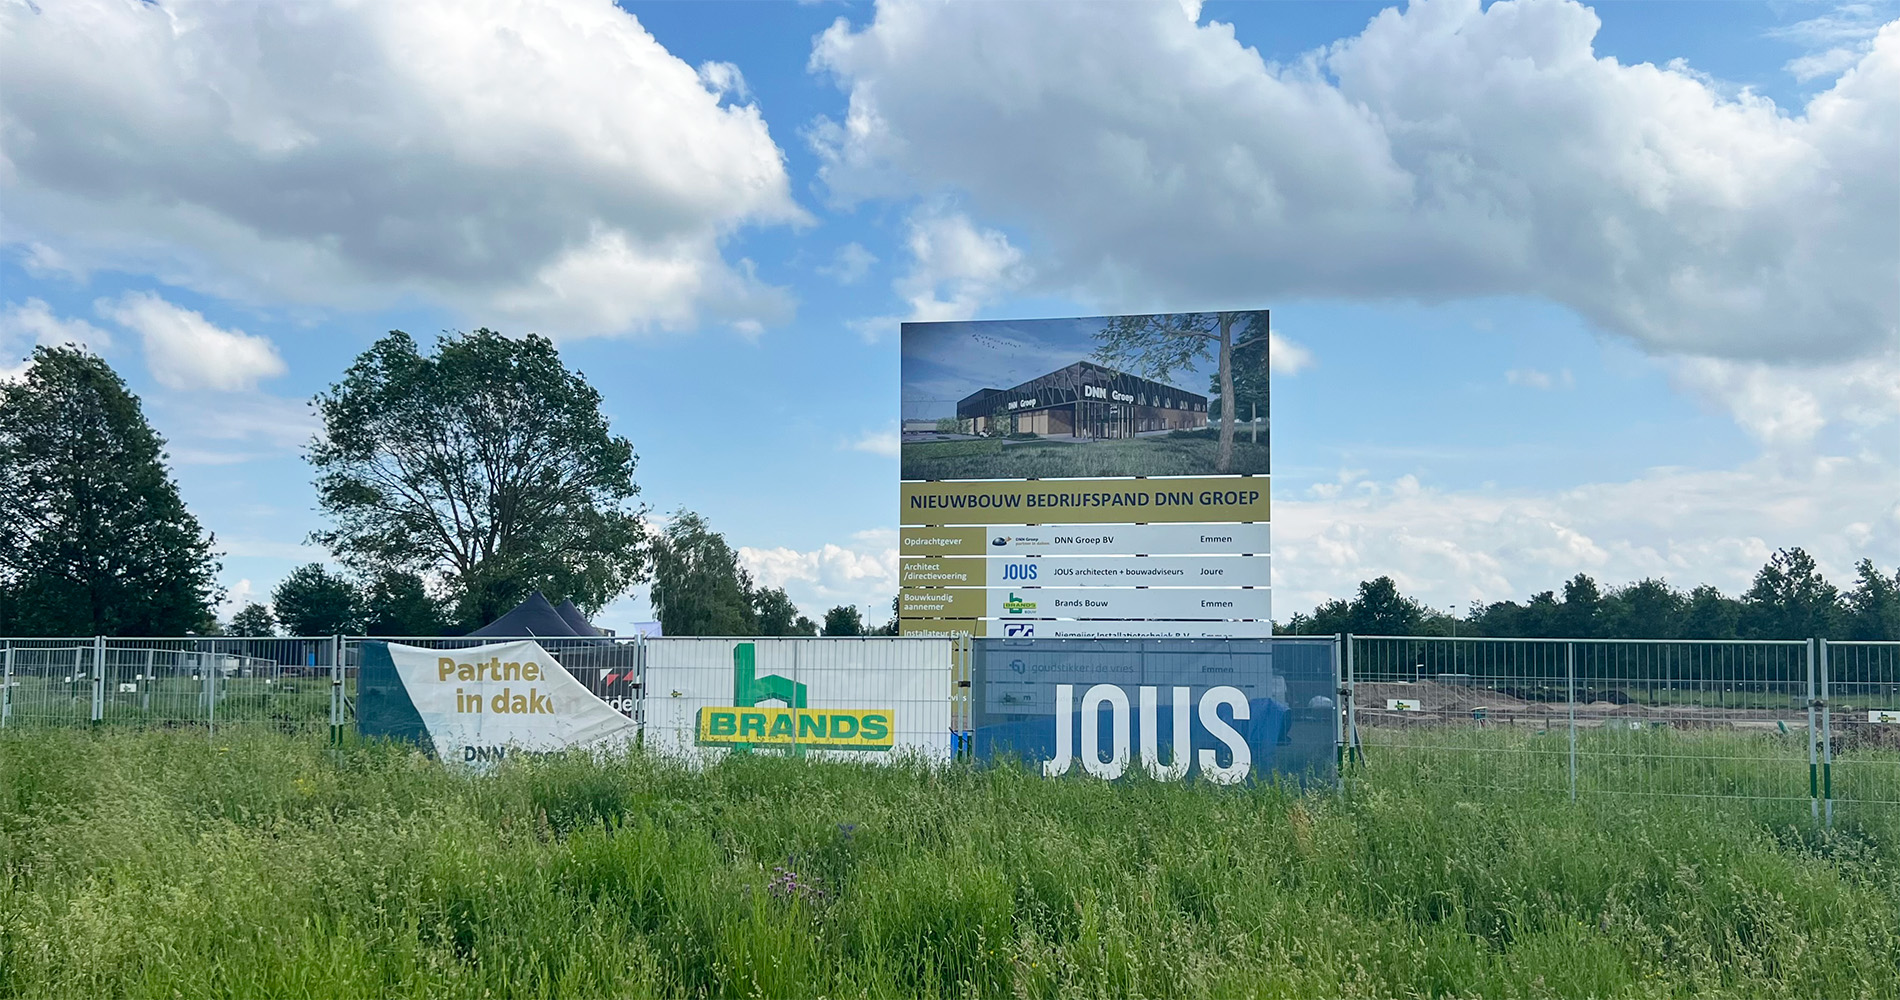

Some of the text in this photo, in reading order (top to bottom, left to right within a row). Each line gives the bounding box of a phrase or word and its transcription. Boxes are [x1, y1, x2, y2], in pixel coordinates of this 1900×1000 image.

[1084, 385, 1134, 404] DNN Groep
[1020, 398, 1037, 408] Groep
[910, 491, 1259, 509] NIEUWBOUW BEDRIJFSPAND DNN GROEP
[904, 537, 962, 546] Opdrachtgever
[1054, 536, 1114, 545] DNN Groep BV
[1200, 535, 1232, 543] Emmen
[904, 563, 940, 571] Architect
[1200, 567, 1223, 576] Joure
[904, 572, 967, 581] /directievoering
[1003, 564, 1037, 580] JOUS
[1054, 568, 1074, 576] JOUS
[1075, 568, 1118, 576] architecten
[904, 593, 954, 602] Bouwkundig
[1055, 599, 1109, 608] Brands Bouw
[1201, 600, 1233, 608] Emmen
[904, 629, 949, 637] Installateur
[1201, 665, 1234, 674] Emmen
[456, 688, 482, 713] in
[709, 712, 889, 740] BRANDS
[1043, 683, 1251, 786] JOUS
[464, 745, 505, 763] DNN
